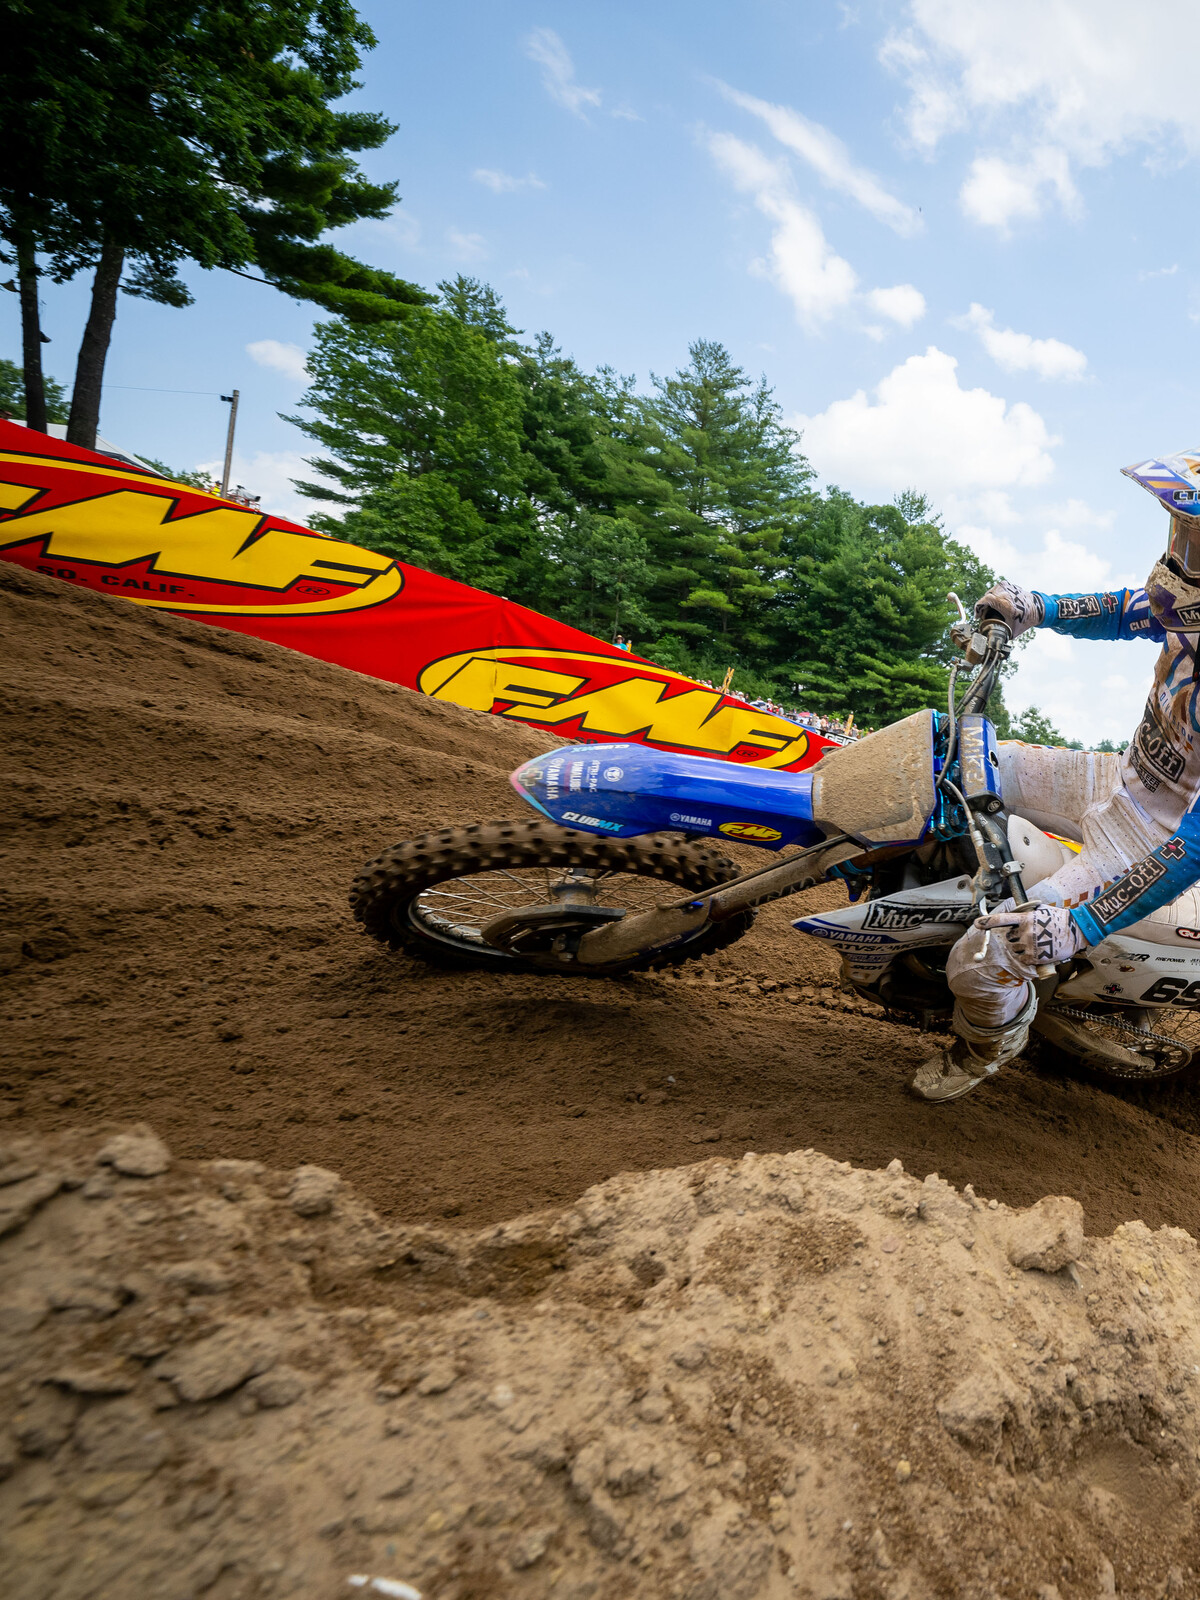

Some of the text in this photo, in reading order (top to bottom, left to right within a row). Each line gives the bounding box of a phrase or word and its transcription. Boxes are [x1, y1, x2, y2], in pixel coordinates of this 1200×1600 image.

[100, 575, 195, 597] CALIF.
[432, 656, 806, 755] FMF
[546, 763, 562, 800] YAMAHA
[561, 811, 624, 832] CLUBMX
[680, 814, 712, 827] YAMAHA
[719, 822, 783, 839] FMF
[1097, 858, 1160, 918] Muc-Off
[872, 905, 979, 929] Muc-Off
[829, 931, 882, 943] YAMAHA
[1037, 908, 1053, 960] FXR
